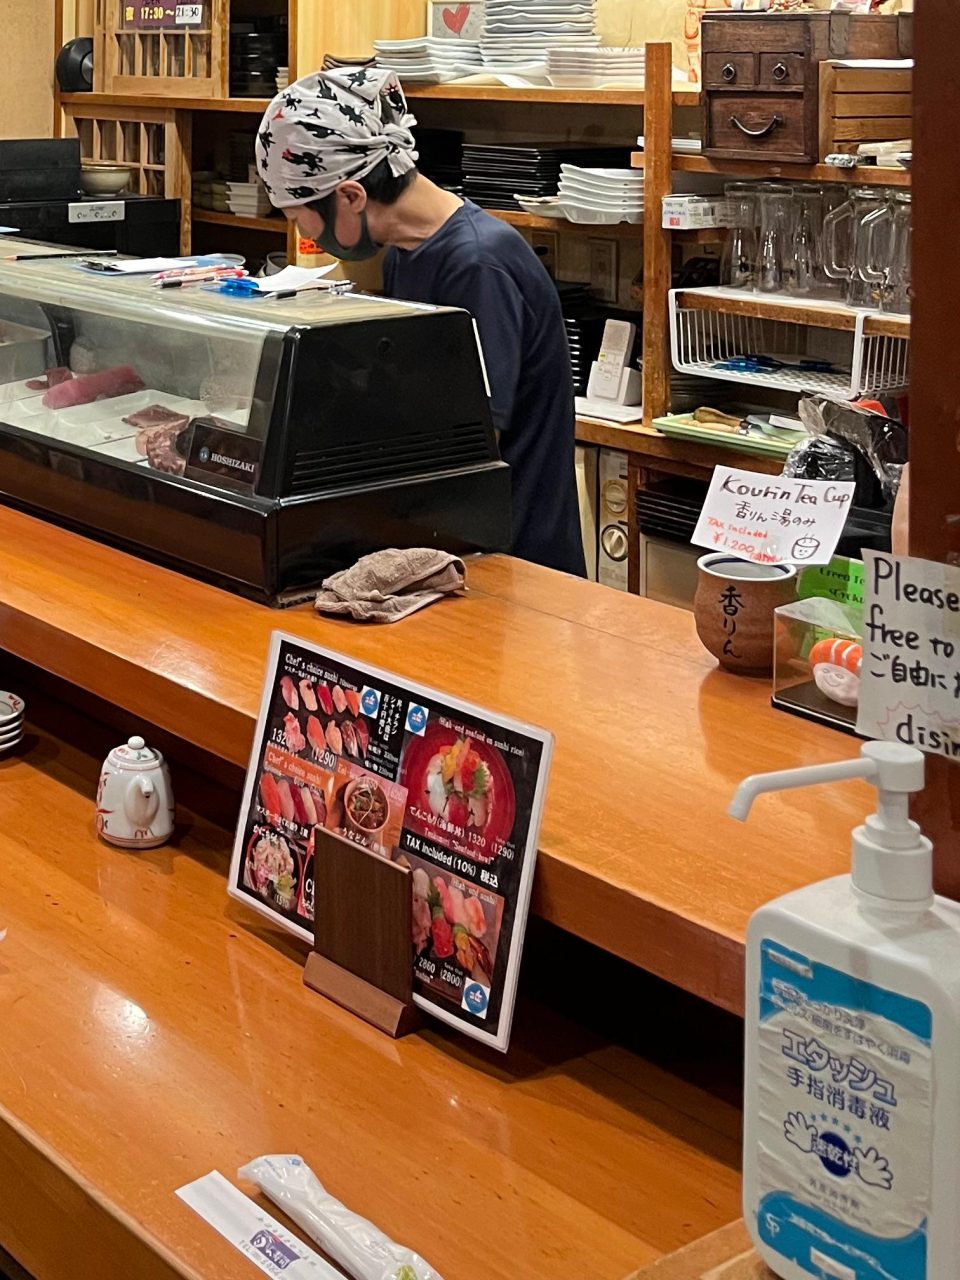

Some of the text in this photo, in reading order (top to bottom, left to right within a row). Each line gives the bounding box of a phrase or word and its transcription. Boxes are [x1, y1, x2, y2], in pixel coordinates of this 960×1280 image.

[211, 453, 255, 473] HOSHIZAKI
[794, 483, 818, 505] Tea
[823, 486, 850, 509] Cup
[873, 556, 960, 612] Please
[718, 586, 744, 659] 香りん
[865, 603, 955, 658] free to
[406, 834, 420, 851] TAX
[781, 1028, 898, 1107] エタッシュ
[787, 1066, 891, 1131] 手指消毒液
